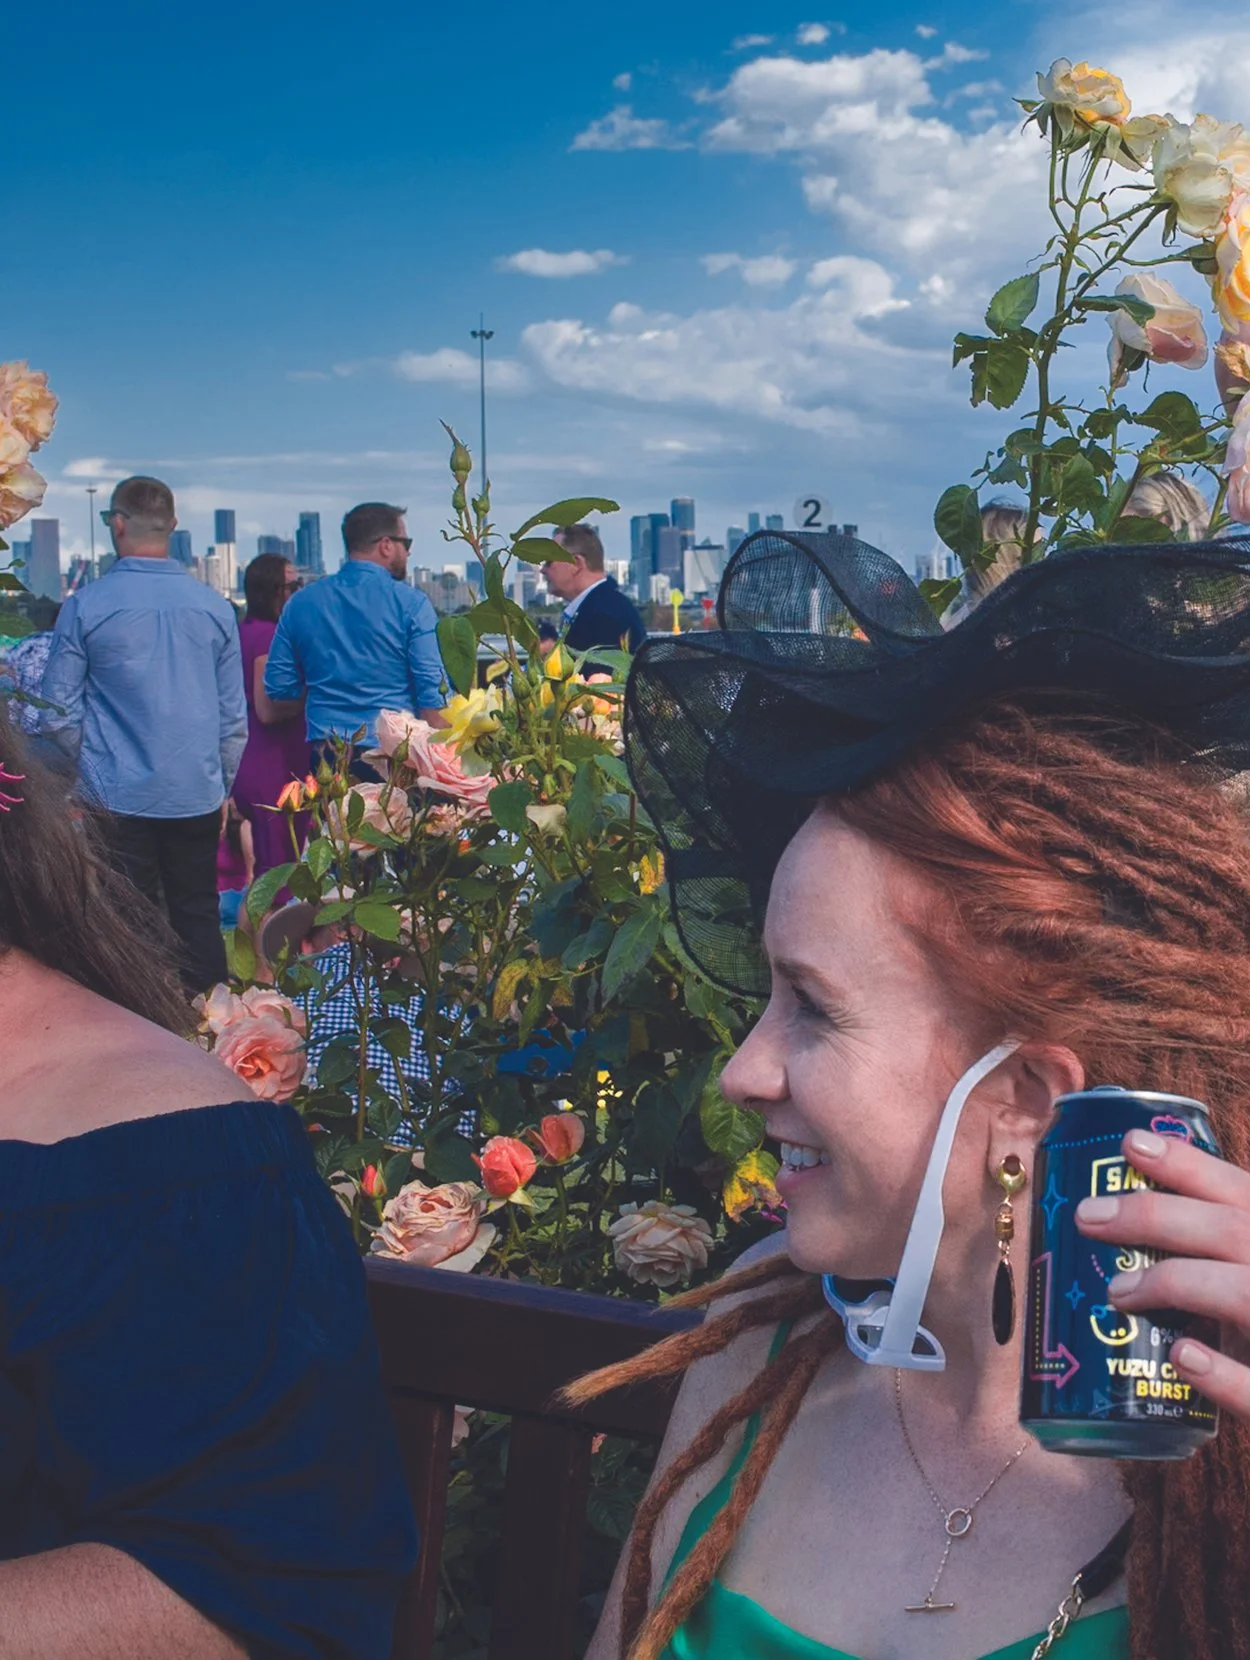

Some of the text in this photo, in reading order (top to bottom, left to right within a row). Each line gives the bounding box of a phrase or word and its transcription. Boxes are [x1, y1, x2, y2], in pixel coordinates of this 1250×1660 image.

[803, 499, 822, 527] 2
[1106, 1358, 1157, 1378] YUZU
[1136, 1380, 1191, 1401] BURST
